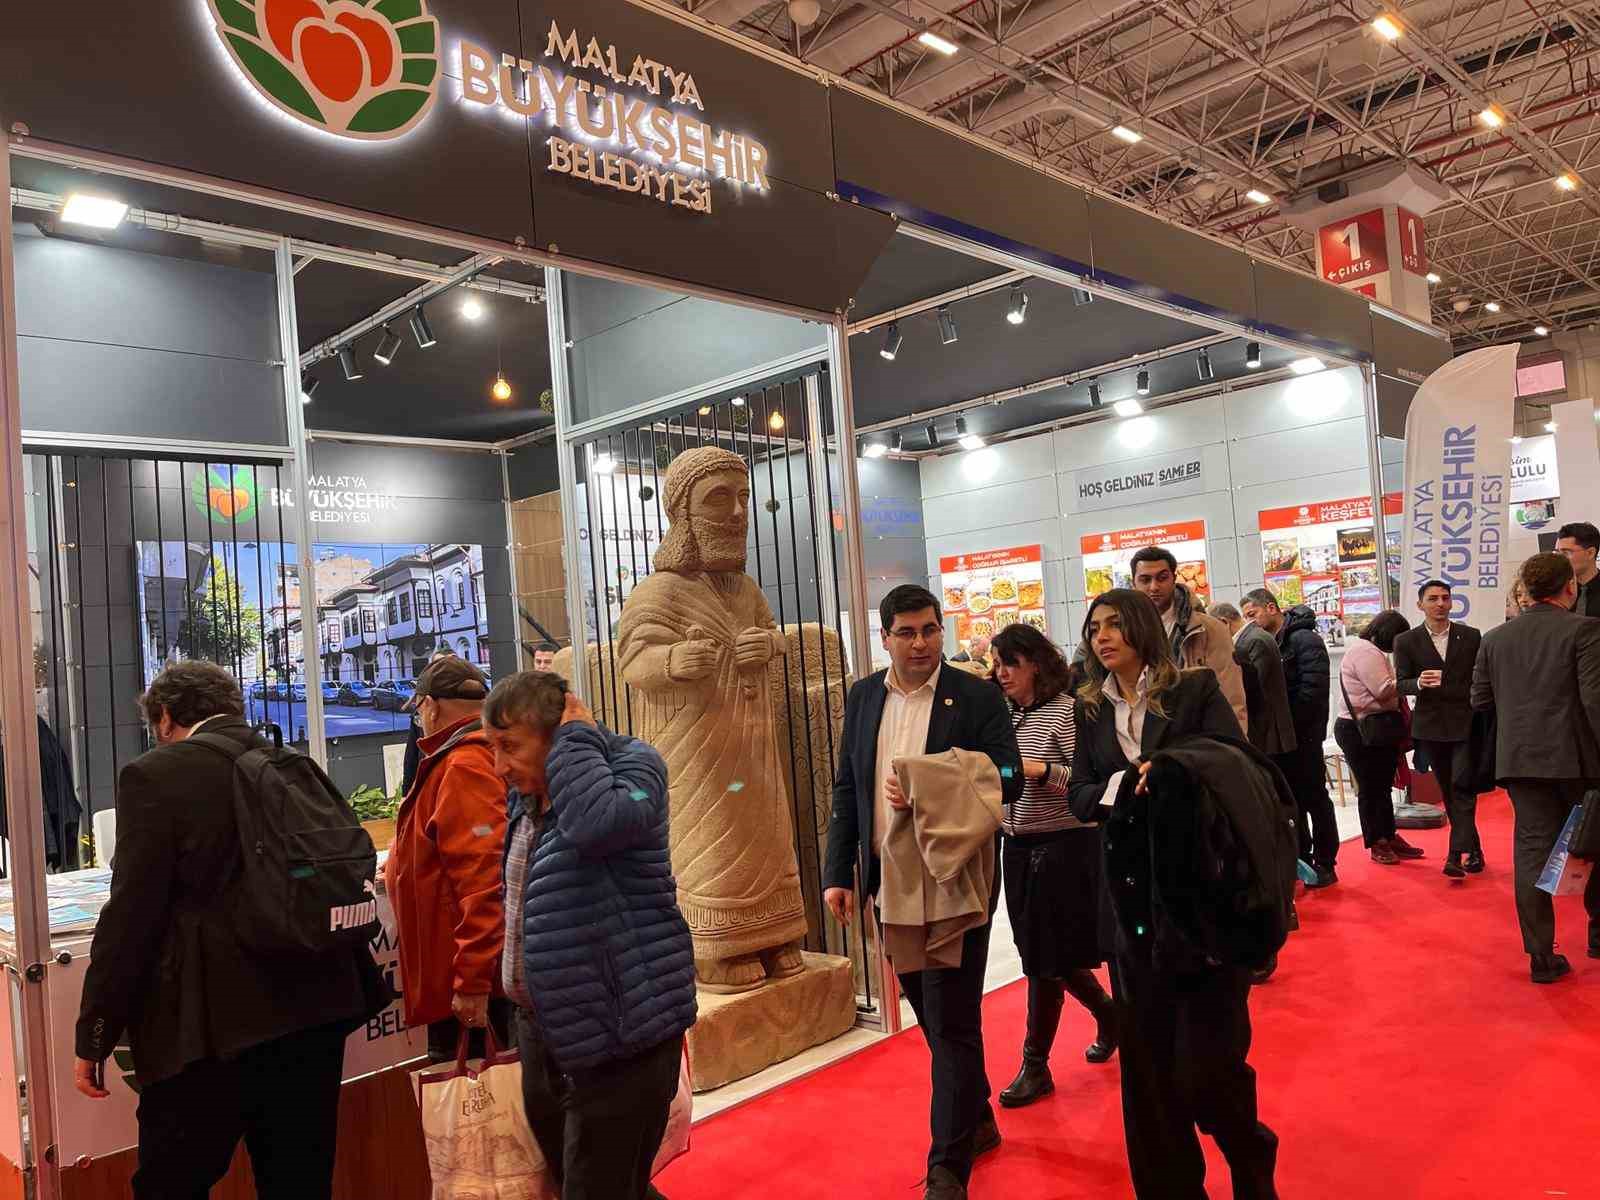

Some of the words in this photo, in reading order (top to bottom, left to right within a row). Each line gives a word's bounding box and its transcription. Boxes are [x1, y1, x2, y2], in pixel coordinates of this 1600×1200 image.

[545, 19, 704, 111] MALATYA
[1343, 222, 1361, 261] 1
[1407, 218, 1417, 256] 1
[1338, 260, 1372, 278] ÇIKIŞ
[1079, 482, 1103, 498] HOŞ
[1186, 461, 1201, 475] ER
[1413, 480, 1434, 585] MALATYA
[1441, 424, 1477, 622] ÜYÜKŞEHİR
[1478, 475, 1503, 589] BELEDİYESİ
[330, 899, 376, 932] PUMA
